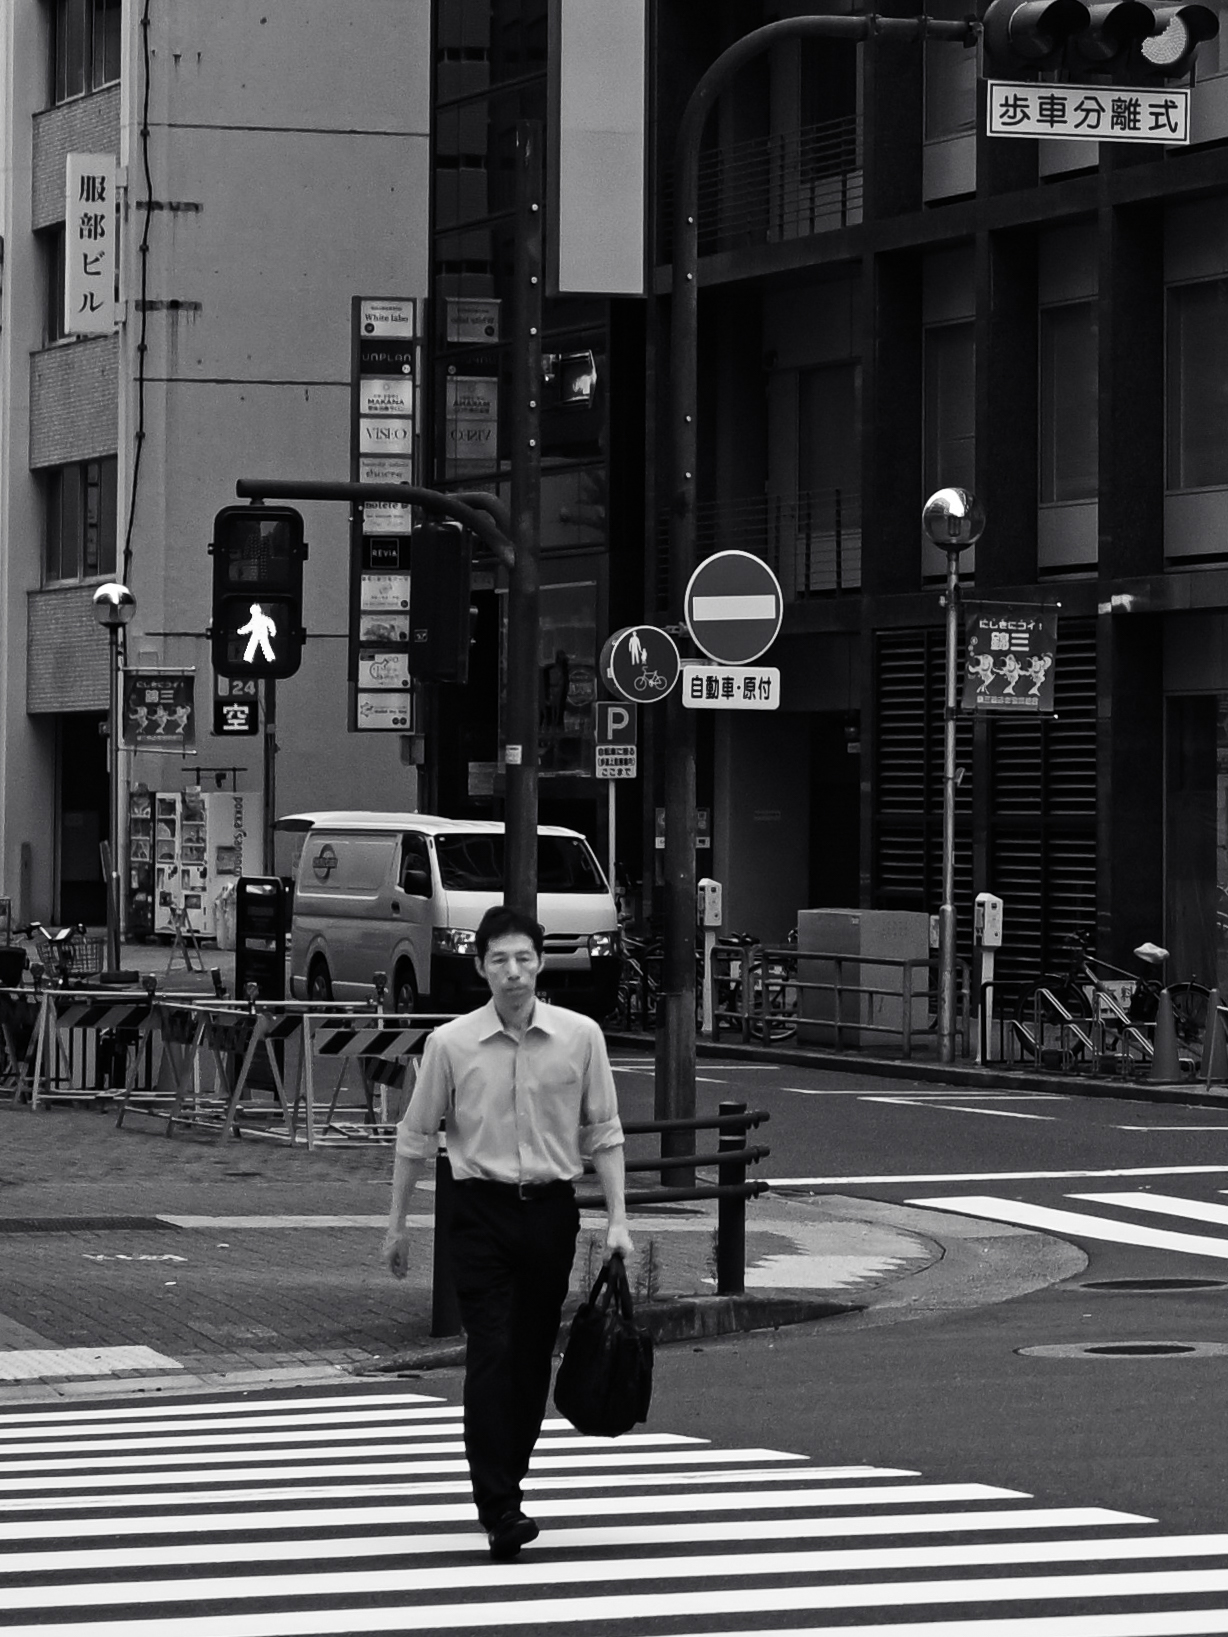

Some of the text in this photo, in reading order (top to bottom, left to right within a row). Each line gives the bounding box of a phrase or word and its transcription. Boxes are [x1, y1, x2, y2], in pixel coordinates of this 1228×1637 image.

[999, 93, 1179, 133] 歩車分離式
[79, 175, 106, 313] 服部ビル
[365, 313, 389, 323] White
[232, 680, 256, 696] 24
[691, 675, 772, 700] 自動車・原付
[222, 702, 249, 731] 空
[607, 706, 630, 740] P
